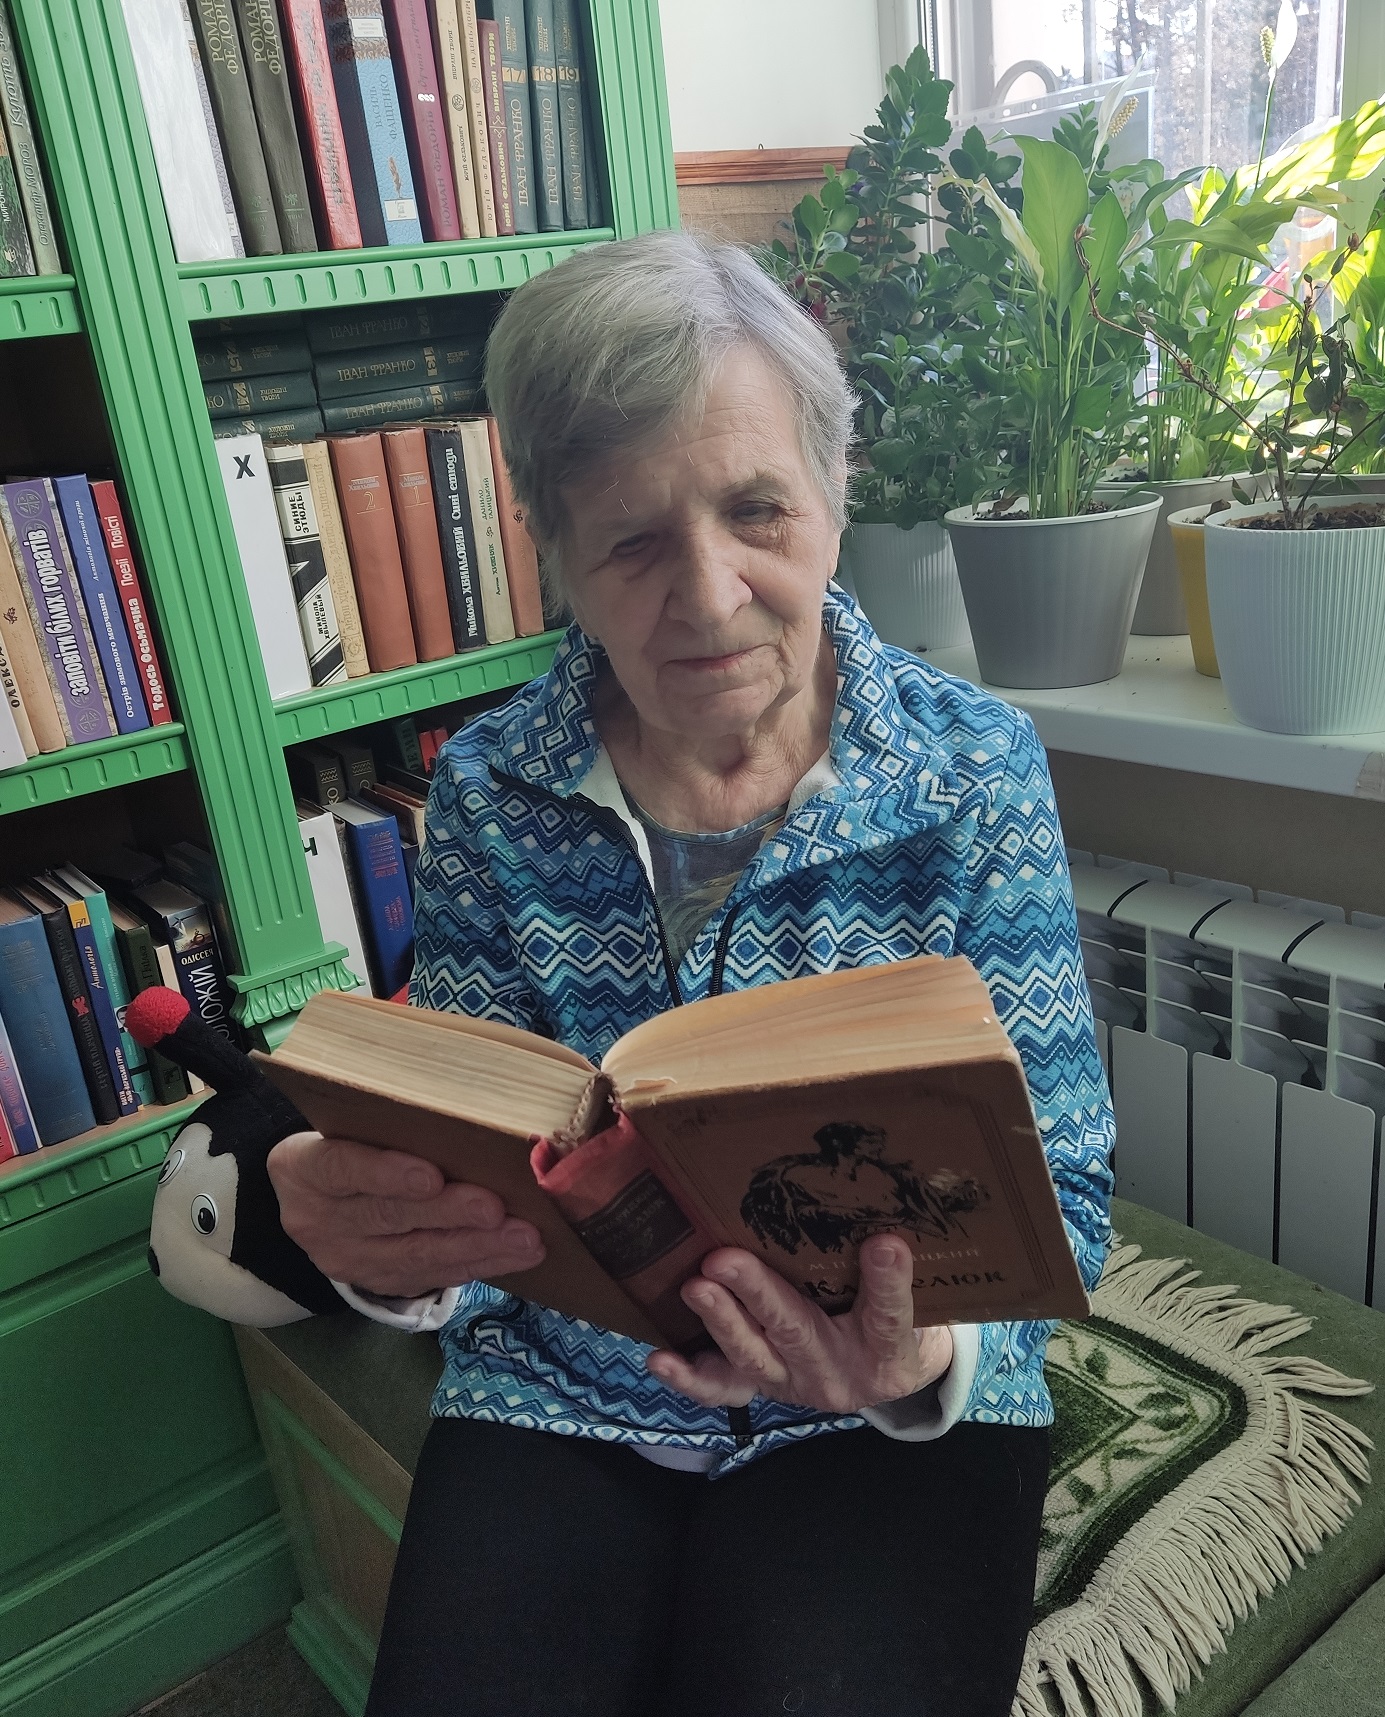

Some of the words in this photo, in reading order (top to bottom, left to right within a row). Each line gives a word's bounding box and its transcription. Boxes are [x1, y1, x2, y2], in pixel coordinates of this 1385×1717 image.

[213, 0, 239, 75] ФЕДОРІ
[488, 32, 496, 69] ТВОРИ
[492, 73, 501, 113] ВИБРАНІ
[502, 68, 526, 83] 17
[533, 66, 556, 82] 18
[560, 65, 580, 82] 19
[379, 73, 399, 141] ФАЩЕНКО
[566, 97, 580, 158] ФРАНКО
[427, 110, 444, 173] ФЕДОРІВ
[475, 102, 489, 180] ФЕДЬКОВИЧ
[509, 98, 528, 162] ФРАНКО
[541, 97, 556, 162] ФРАНКО
[19, 142, 39, 189] МОРОЗ
[499, 140, 510, 200] ФЕДЬКОВИЧ
[515, 165, 530, 207] ІВАН
[548, 165, 560, 206] ІВАН
[571, 162, 583, 201] ІВАН
[436, 178, 452, 227] РОМАН
[504, 201, 513, 228] ЮРІЙ
[329, 321, 362, 340] ІВАН
[365, 316, 409, 336] ФРАНКО
[337, 365, 370, 383] ІВАН
[370, 358, 417, 377] ФРАНКО
[423, 346, 438, 377] 13
[344, 403, 376, 421] ІВАН
[376, 396, 424, 415] ФРАНКО
[429, 384, 444, 413] 14
[232, 453, 256, 480] Х
[444, 447, 457, 490] етюди
[287, 495, 301, 532] СИНИЕ
[295, 490, 310, 534] ЭТЮДЫ
[363, 490, 376, 510] 2
[450, 492, 461, 521] Сині
[477, 488, 488, 521] ДАНИЛО
[482, 476, 494, 520] ГАЛИЦЬКИЙ
[104, 515, 125, 549] Повісті
[23, 528, 64, 598] горватів
[114, 558, 135, 587] Поезії
[454, 525, 472, 596] ХВИЛЬОВИЙ
[45, 591, 74, 637] білих
[98, 593, 116, 641] мовчання
[128, 598, 153, 663] Осьмачка
[316, 593, 331, 640] ХВЫЛЕВЫЙ
[464, 596, 478, 638] Микола
[54, 640, 91, 698] заповіти
[109, 640, 129, 685] зимового
[118, 685, 136, 718] Острів
[85, 945, 104, 989] Антологія
[181, 948, 214, 966] ОДІССЕЯ
